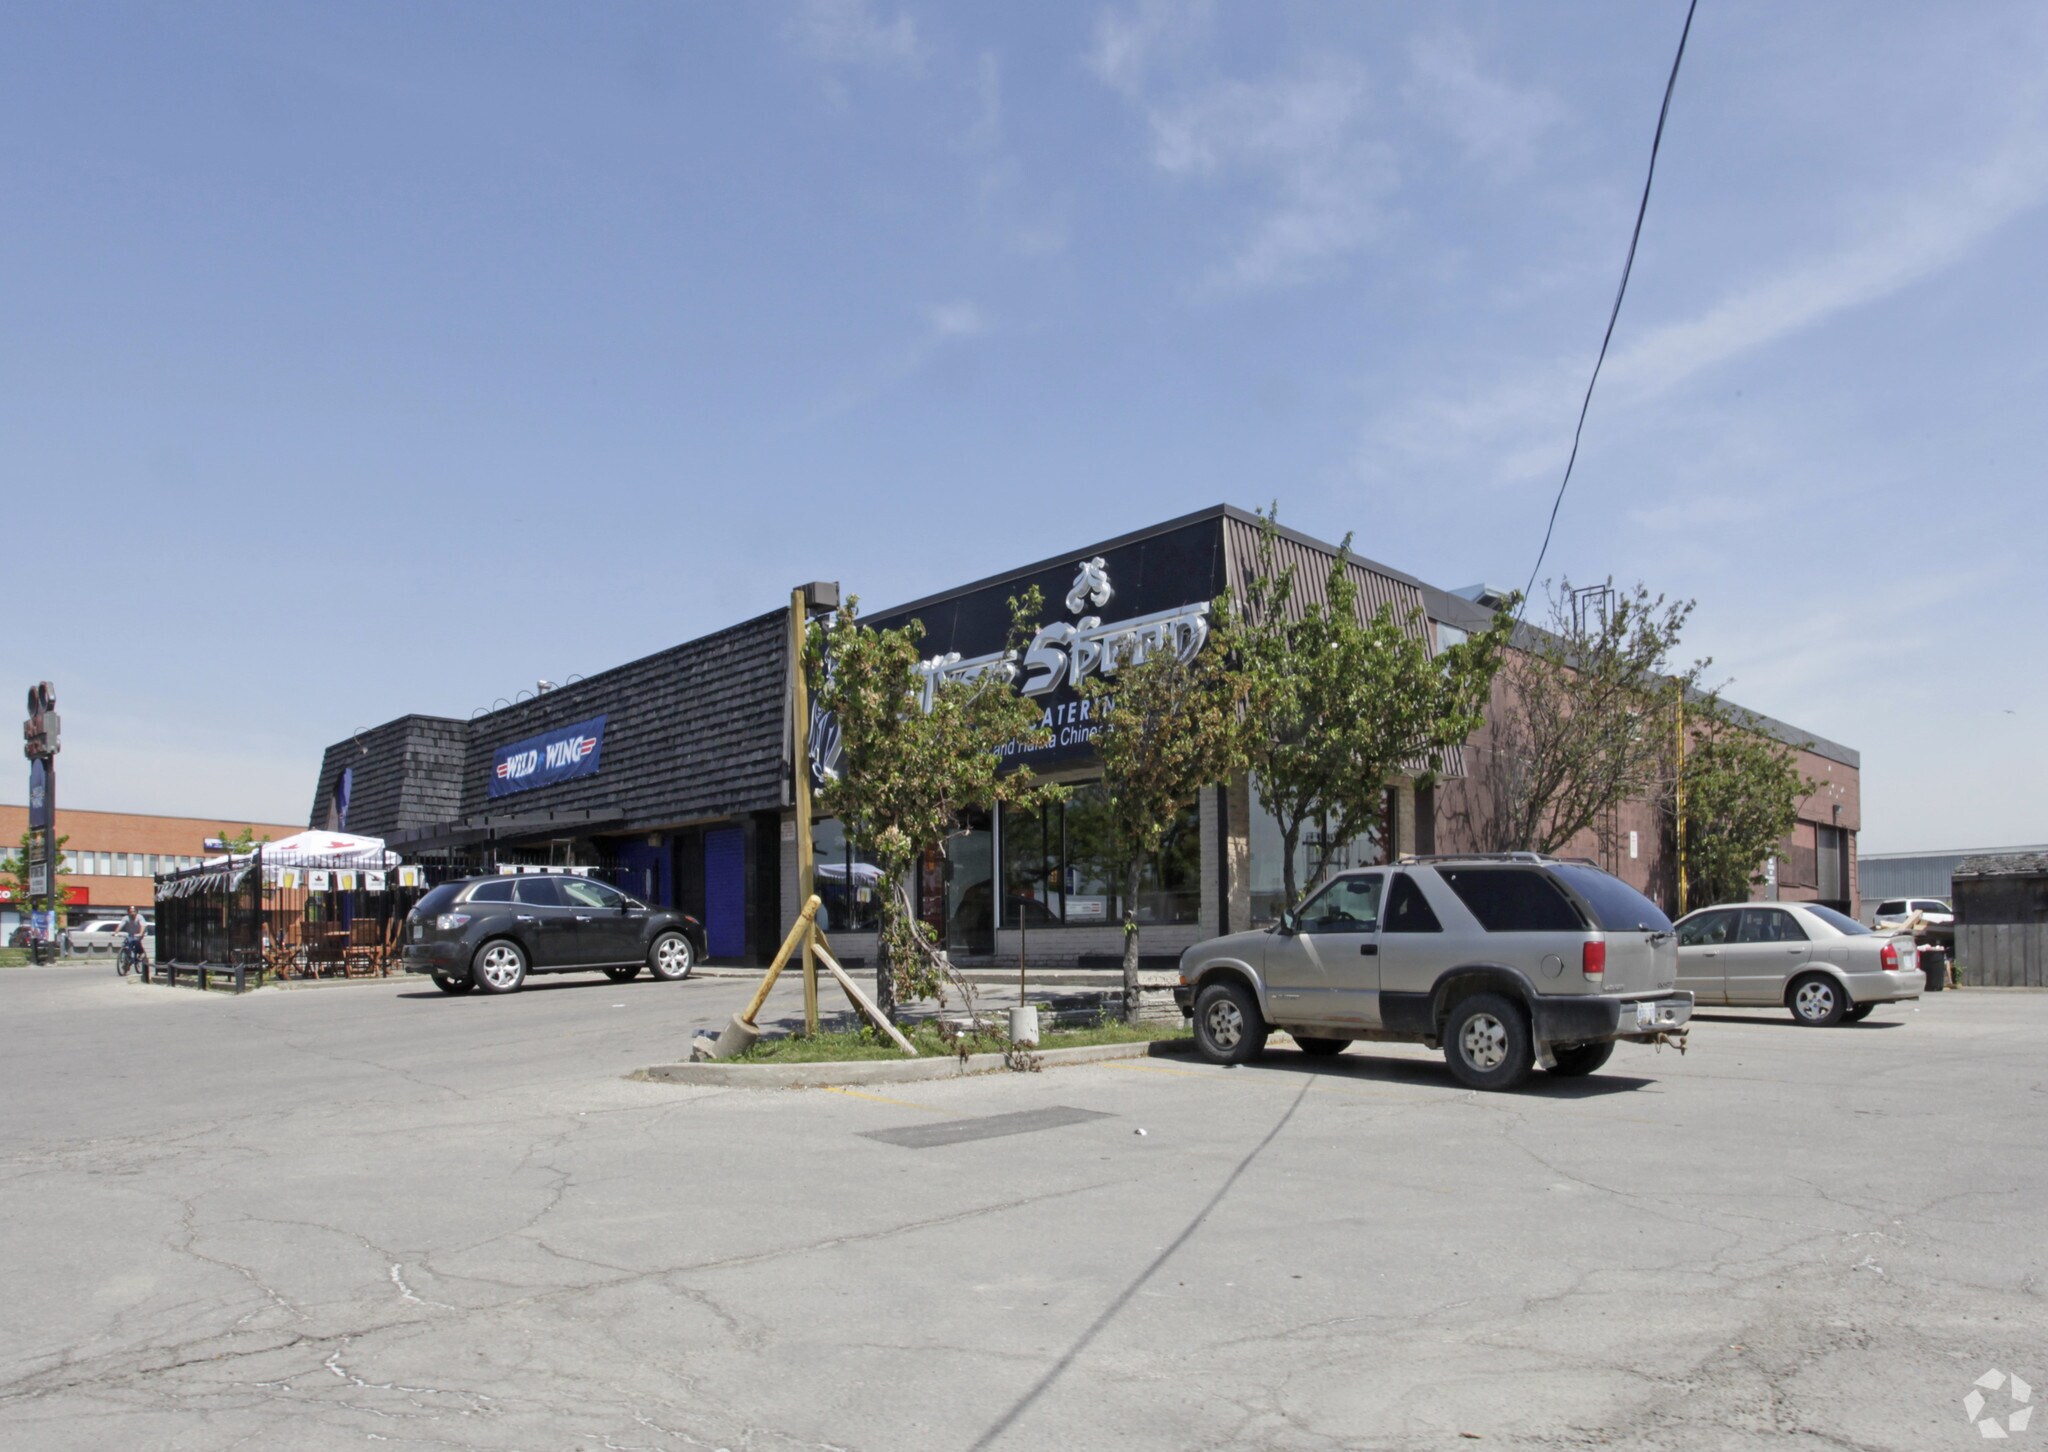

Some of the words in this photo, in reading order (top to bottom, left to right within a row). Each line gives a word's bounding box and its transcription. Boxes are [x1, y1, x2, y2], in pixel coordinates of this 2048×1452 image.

[1028, 695, 1116, 731] ATERN
[506, 749, 538, 780] WILD
[545, 735, 584, 770] WING
[993, 736, 1015, 756] and
[1060, 723, 1115, 746] Chine
